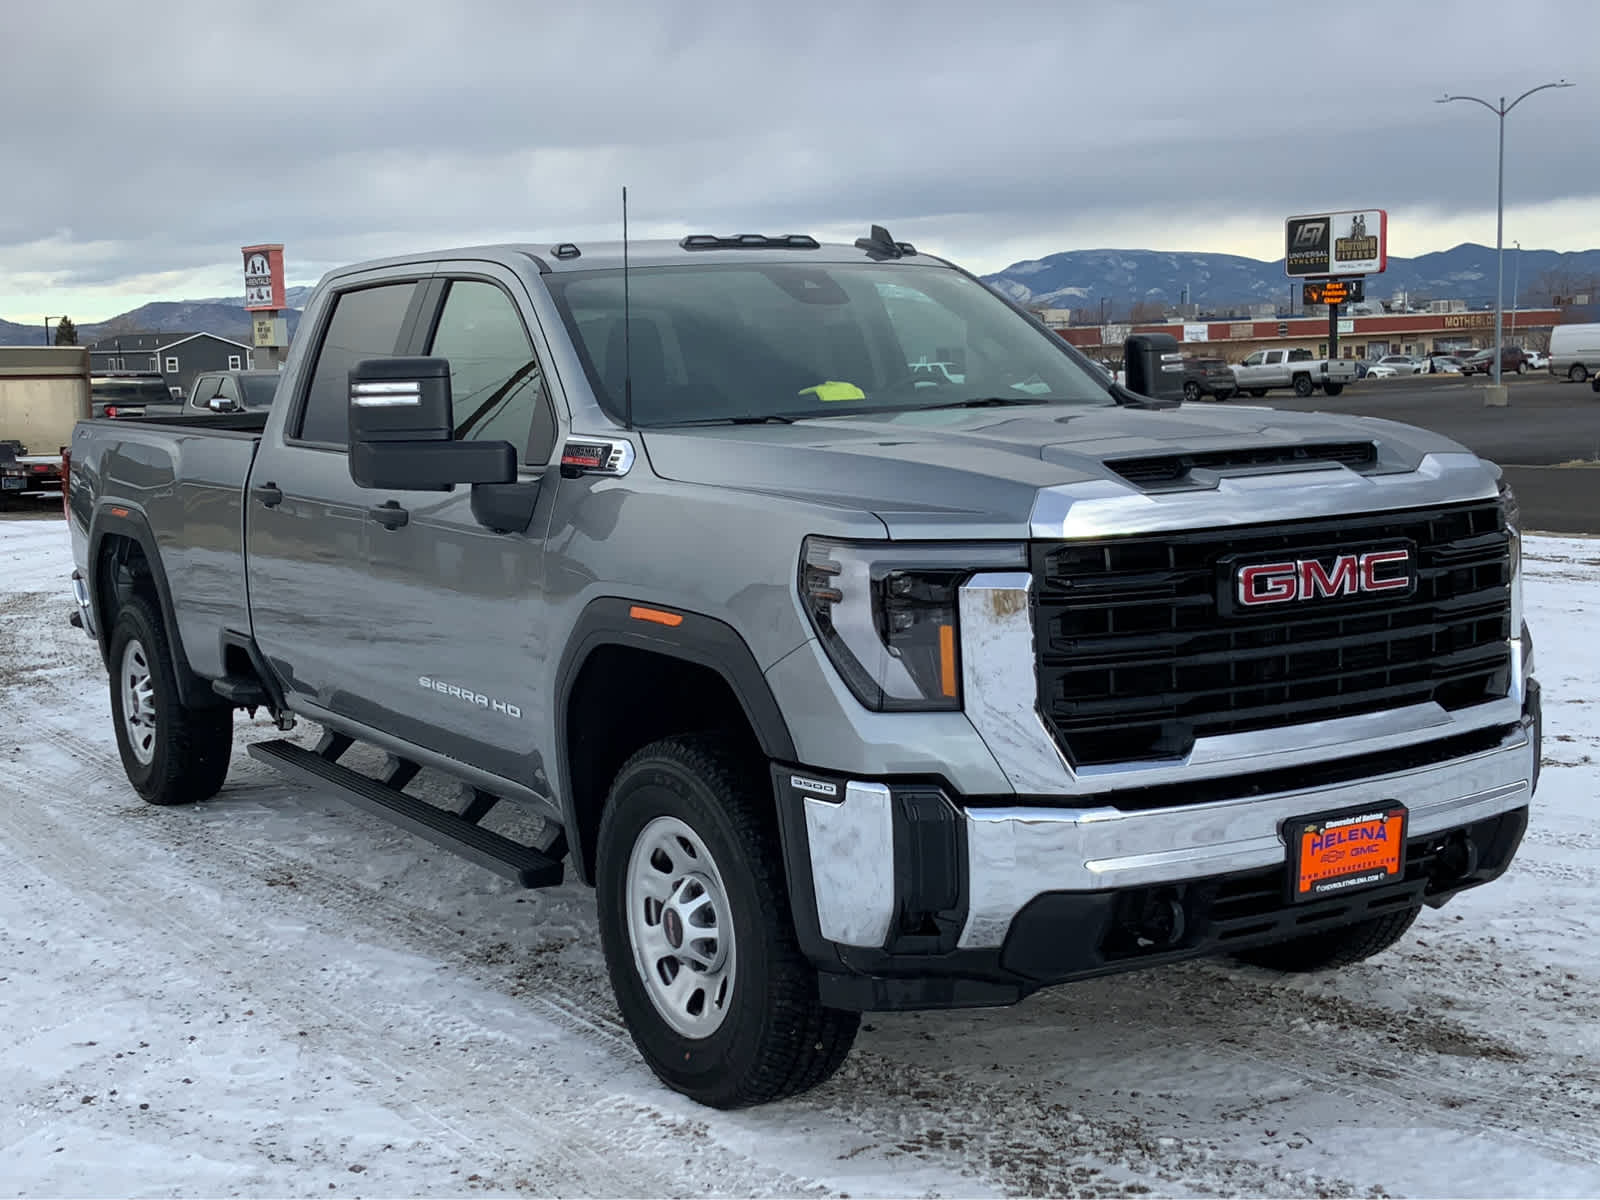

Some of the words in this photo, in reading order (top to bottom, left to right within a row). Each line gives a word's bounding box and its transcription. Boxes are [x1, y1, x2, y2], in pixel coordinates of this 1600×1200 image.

[1288, 257, 1328, 265] ATHLETIC
[1238, 549, 1409, 606] GMC
[419, 676, 489, 708] SIERRA
[492, 699, 522, 719] HD
[794, 779, 834, 791] 3500
[1311, 825, 1387, 856] HELENA
[1350, 844, 1380, 857] GMC
